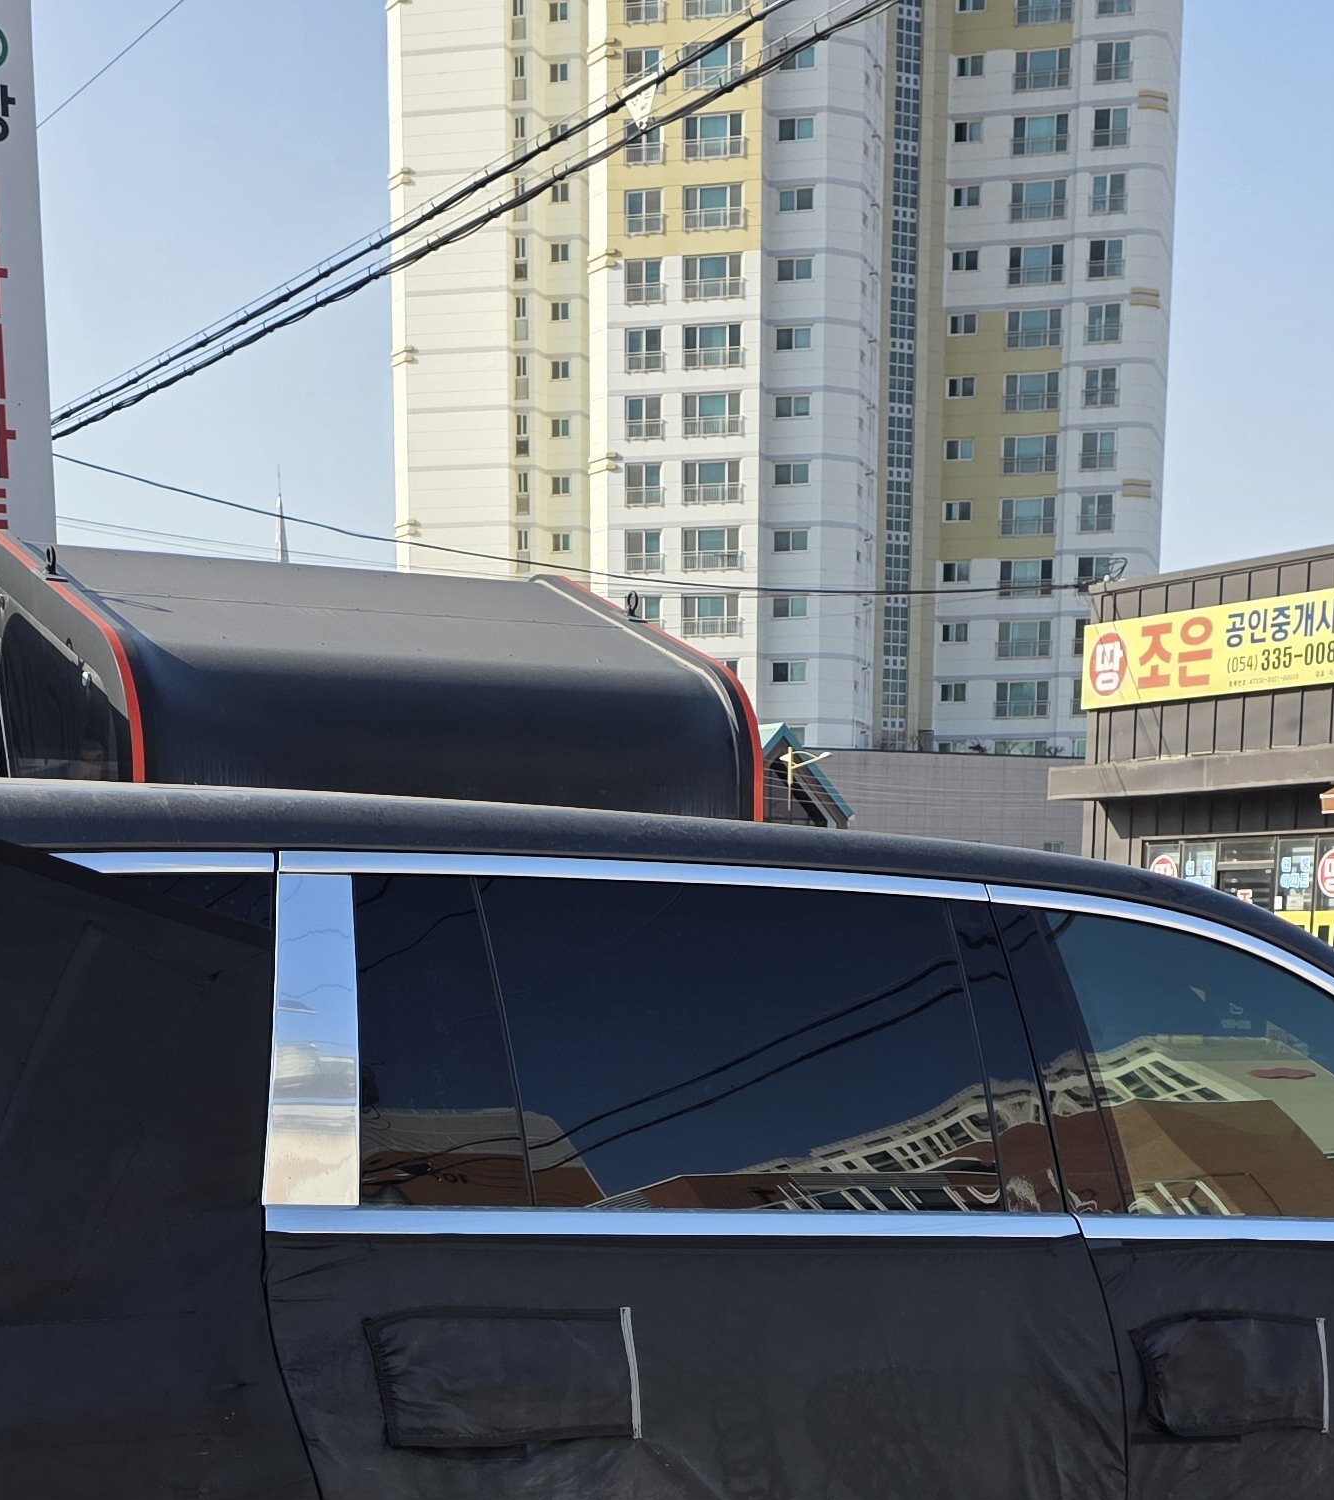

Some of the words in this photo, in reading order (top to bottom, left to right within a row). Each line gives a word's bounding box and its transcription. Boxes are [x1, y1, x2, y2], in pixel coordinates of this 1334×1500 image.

[1095, 641, 1123, 691] 땅
[1137, 616, 1213, 690] 조은
[1227, 654, 1259, 674] (054)
